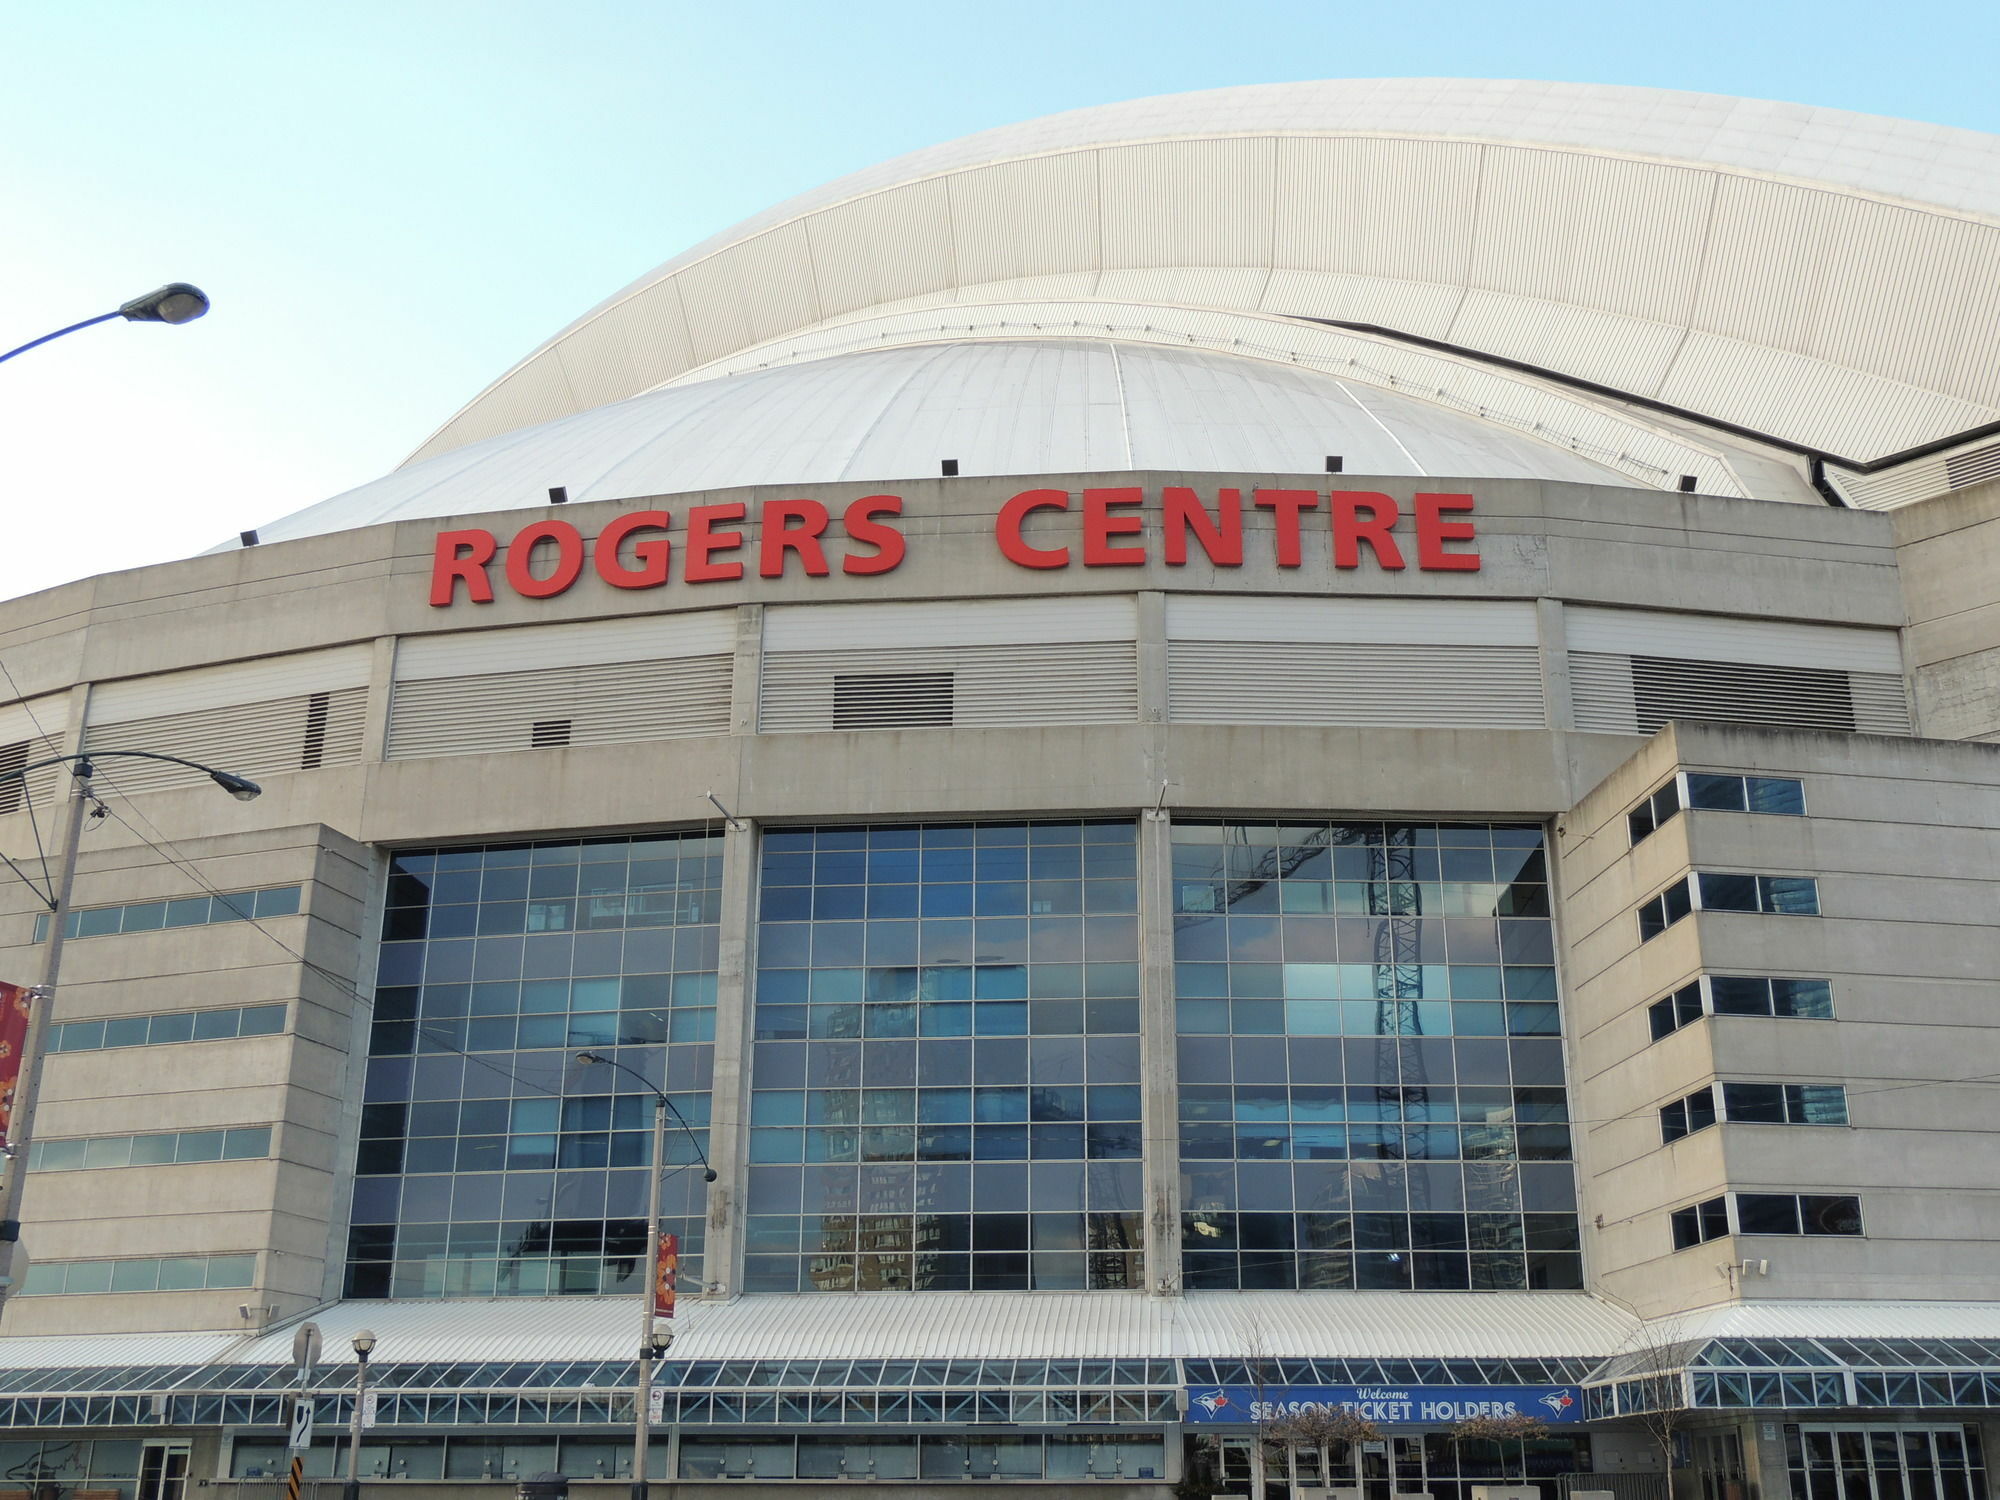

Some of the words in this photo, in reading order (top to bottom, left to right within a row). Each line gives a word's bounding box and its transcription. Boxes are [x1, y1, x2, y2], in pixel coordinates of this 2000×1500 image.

[429, 495, 906, 607] ROGERS
[995, 487, 1481, 572] CENTRE
[1356, 1387, 1409, 1400] Welcome
[1249, 1401, 1333, 1420] SEASON
[1340, 1401, 1413, 1420] TICKET
[1420, 1401, 1517, 1420] HOLDERS
